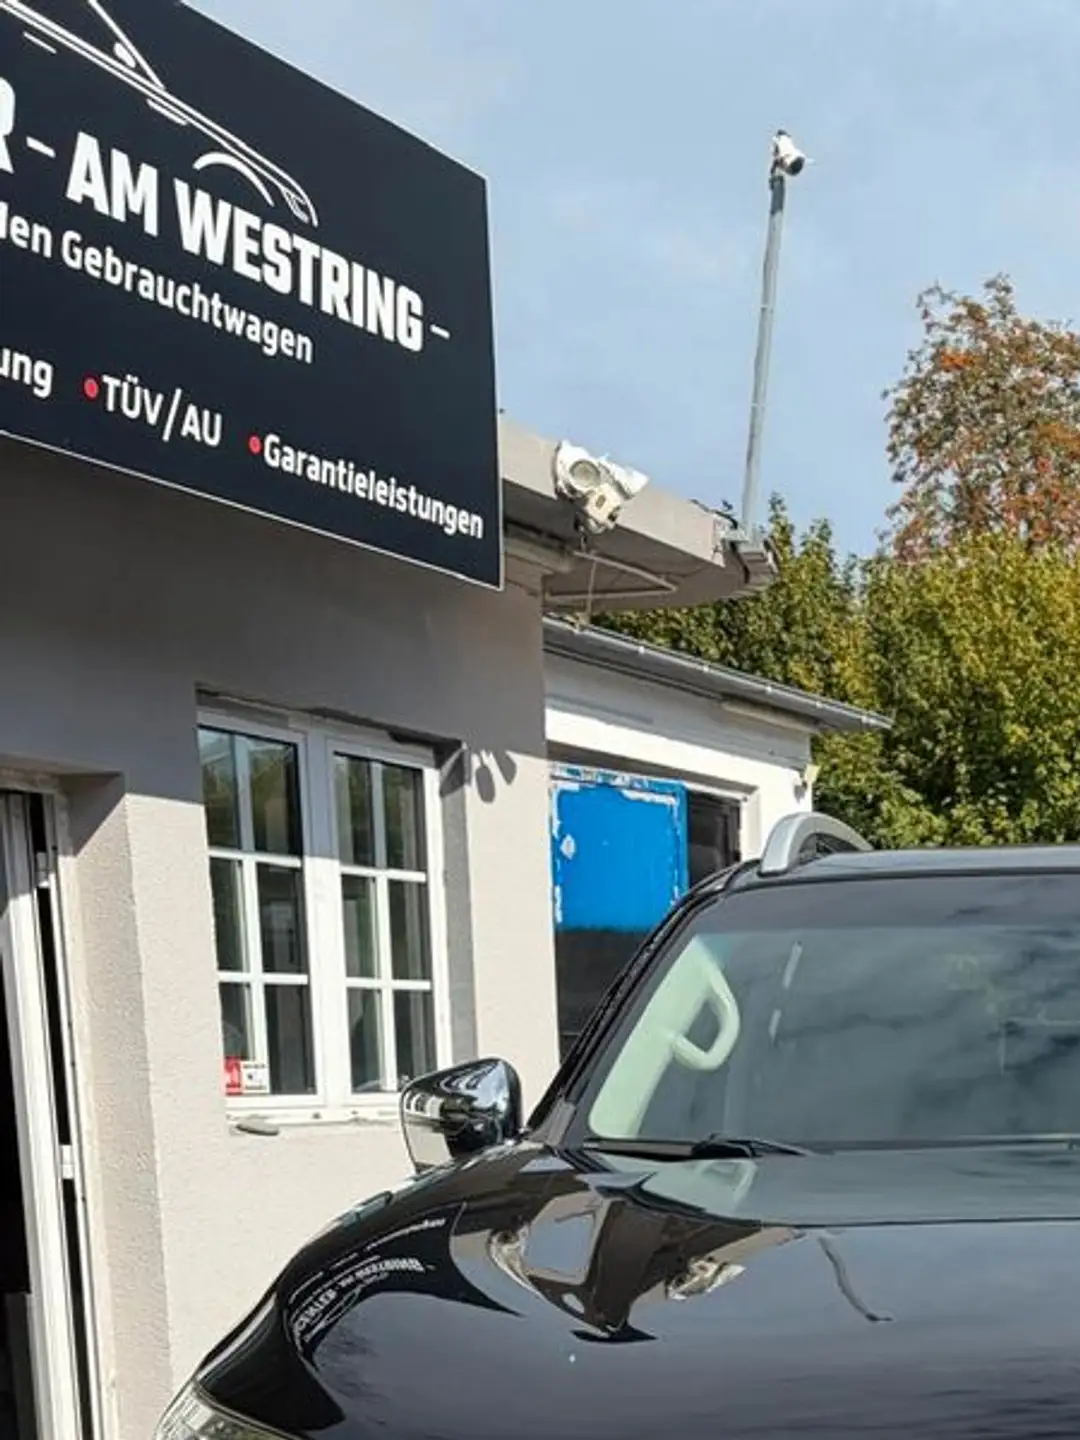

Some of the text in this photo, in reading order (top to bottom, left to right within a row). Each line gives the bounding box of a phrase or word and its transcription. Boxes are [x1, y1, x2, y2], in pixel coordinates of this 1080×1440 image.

[61, 230, 314, 364] Gebrauchtwagen
[66, 131, 158, 237] AM
[173, 177, 422, 352] WESTRING
[102, 374, 223, 448] TÜV/AU
[263, 433, 483, 539] Garantieleistungen
